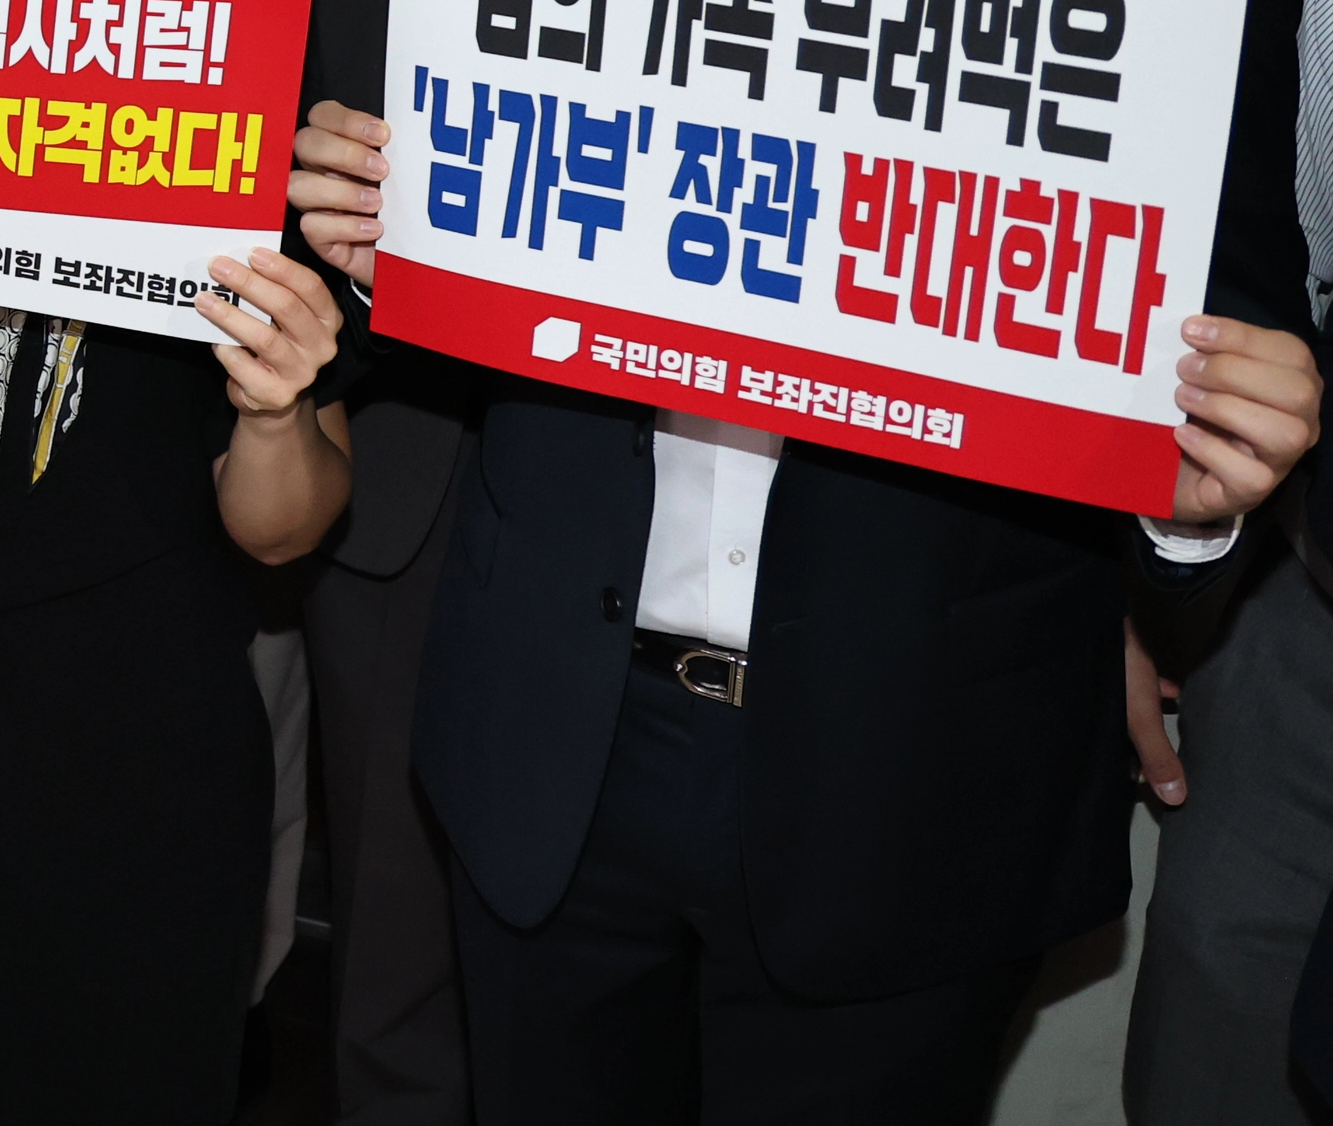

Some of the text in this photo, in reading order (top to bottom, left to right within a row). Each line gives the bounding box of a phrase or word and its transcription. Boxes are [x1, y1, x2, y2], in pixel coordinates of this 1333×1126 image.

[413, 65, 1167, 376] '남가부' 장관 반대한다
[590, 335, 964, 451] 국민의힘 보좌진협의회
